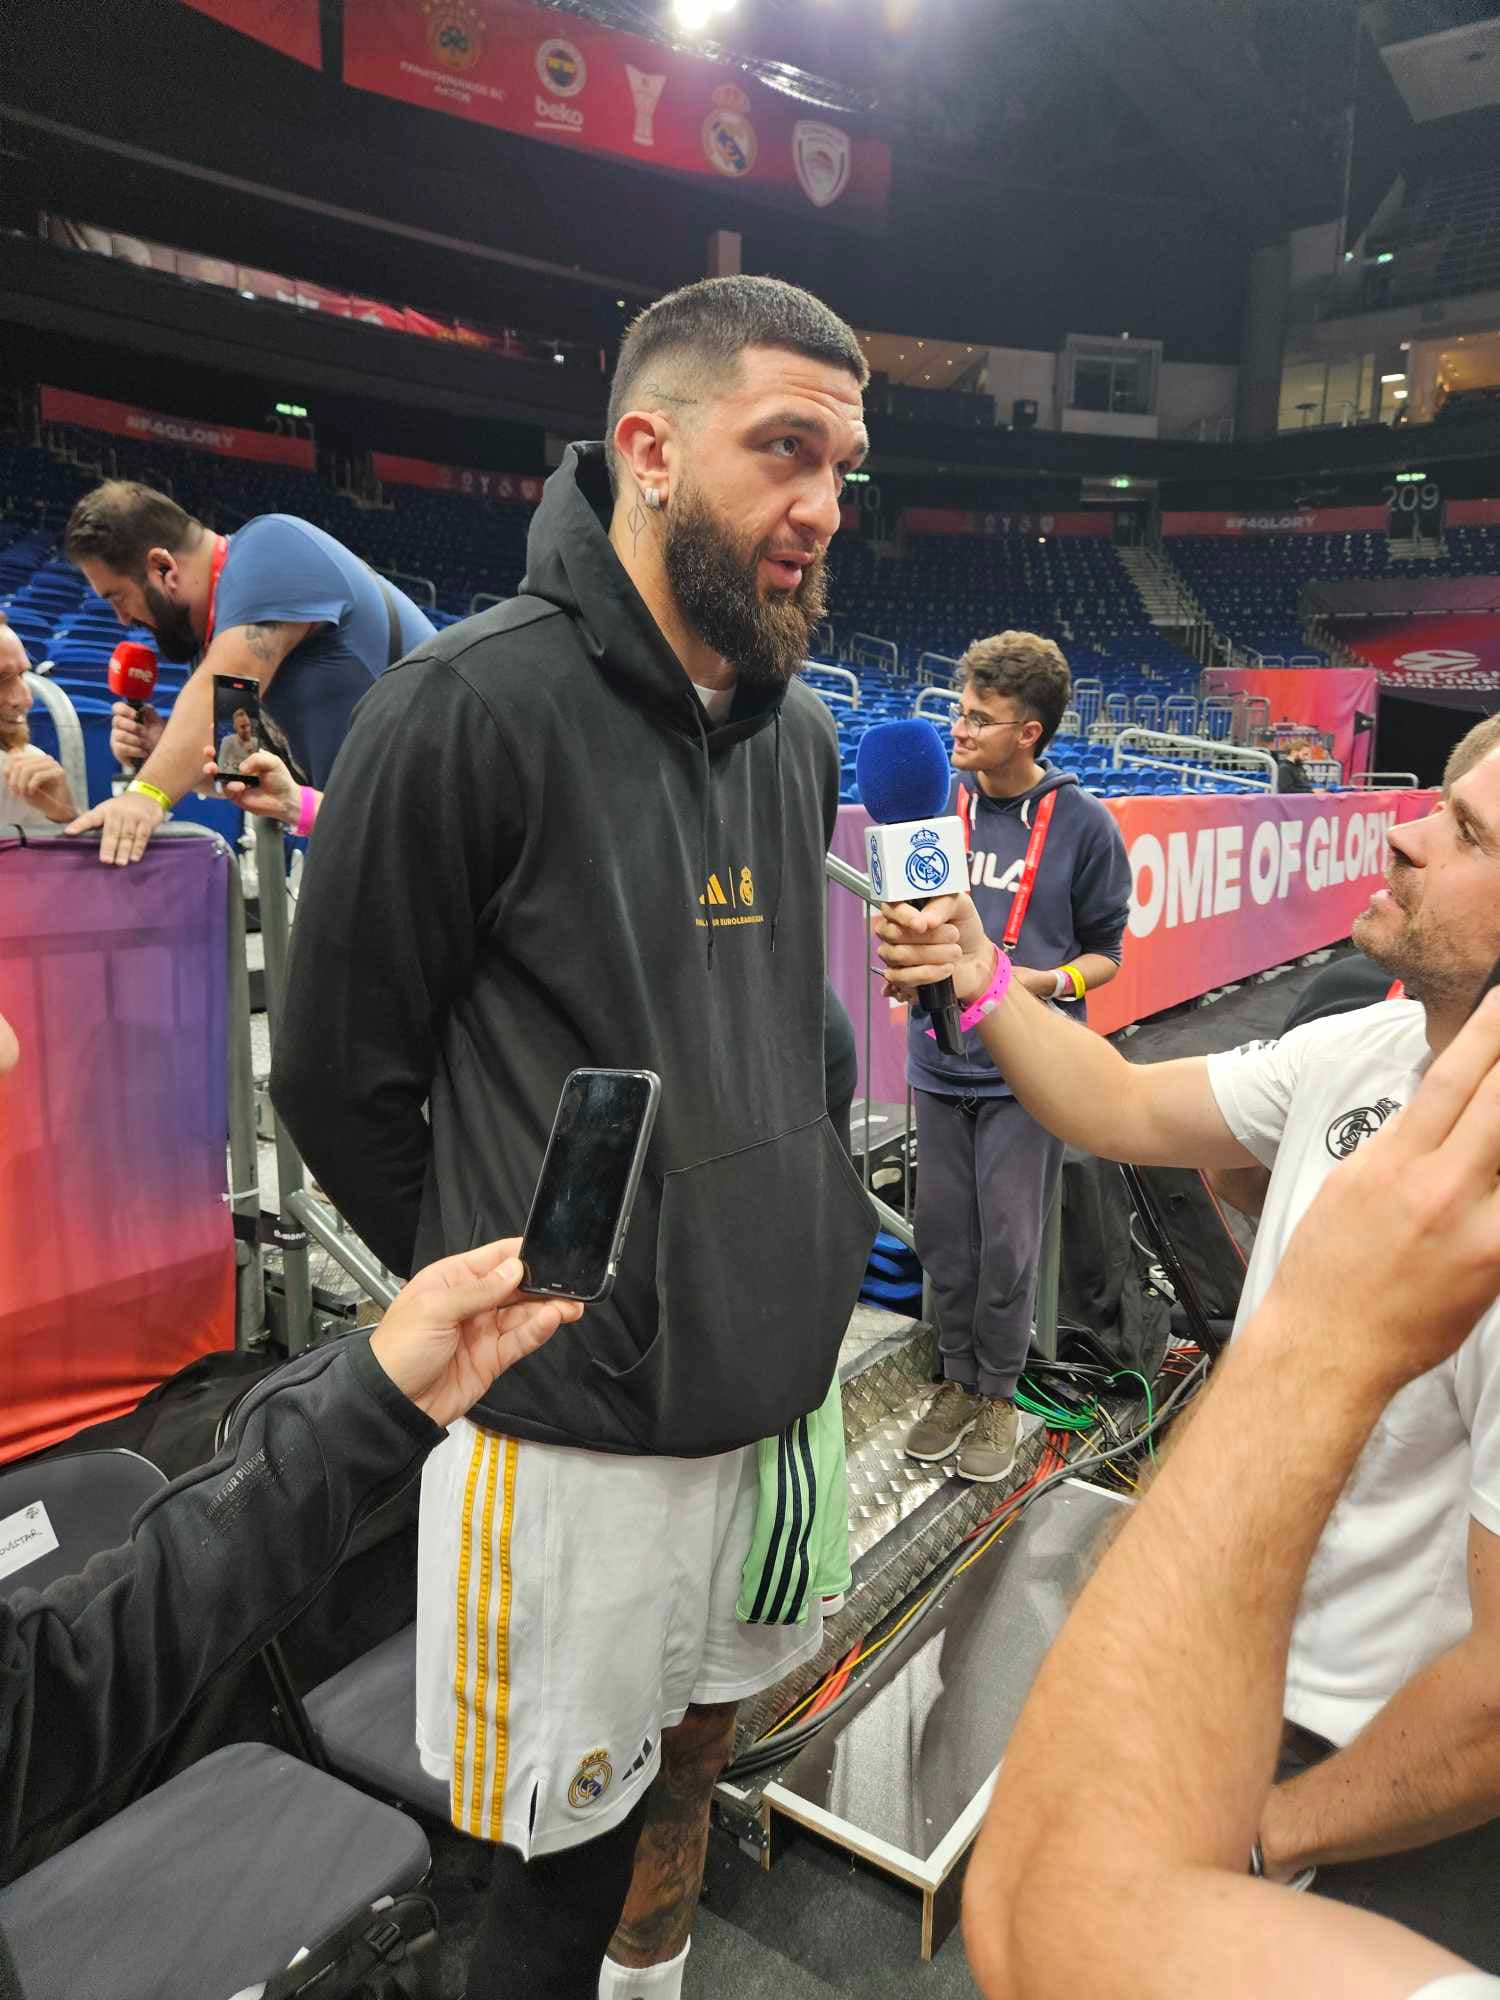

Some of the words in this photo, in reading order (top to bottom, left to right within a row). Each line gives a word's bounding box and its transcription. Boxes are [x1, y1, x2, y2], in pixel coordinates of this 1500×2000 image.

[1381, 483, 1440, 512] 209
[967, 850, 1026, 893] ILA
[1126, 825, 1244, 938] OME
[1250, 820, 1303, 905] OF
[1305, 811, 1397, 892] GLORY
[222, 1477, 239, 1498] FOR
